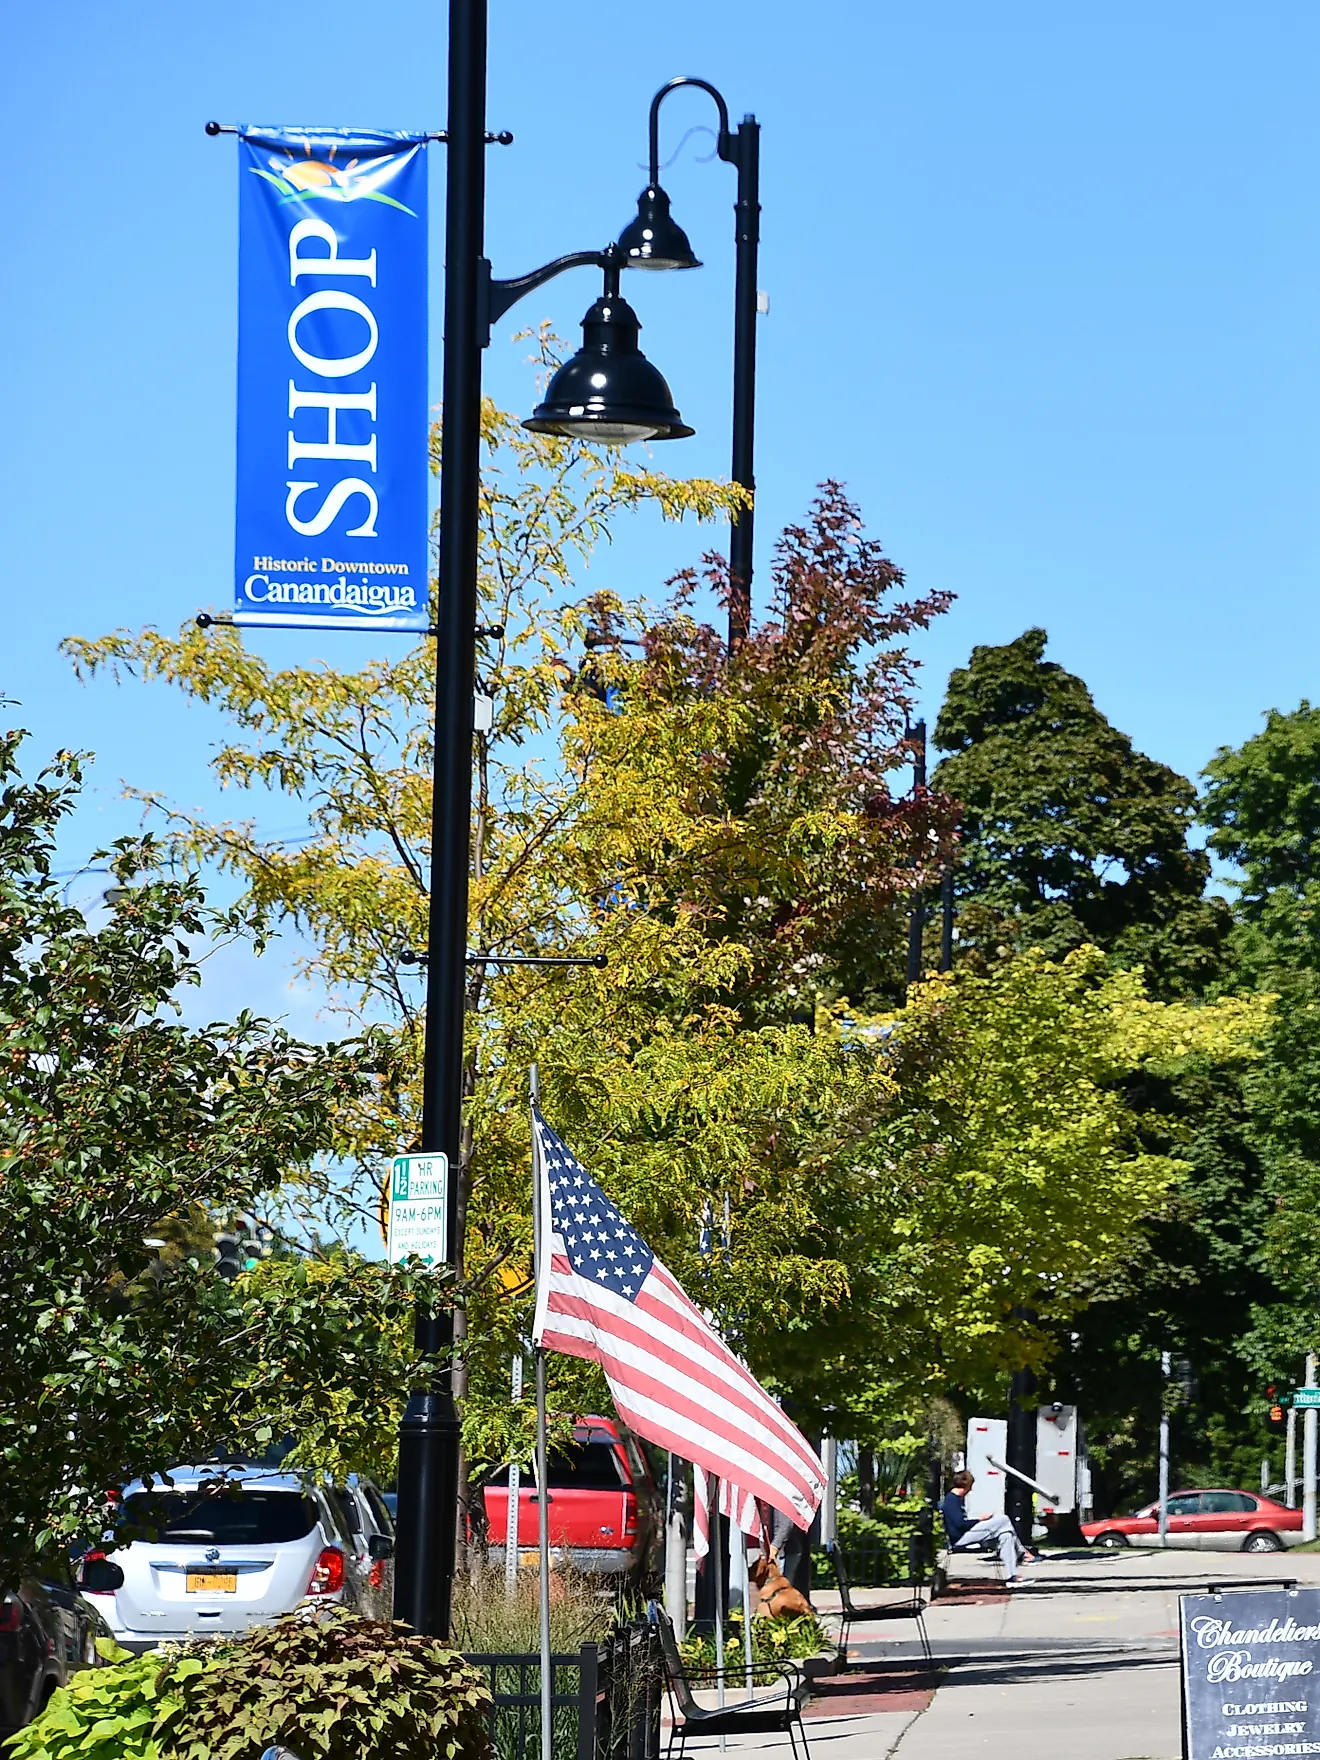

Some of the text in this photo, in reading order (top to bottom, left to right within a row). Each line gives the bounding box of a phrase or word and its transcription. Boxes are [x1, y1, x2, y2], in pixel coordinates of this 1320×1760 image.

[285, 217, 379, 538] SHOP
[253, 556, 410, 576] Historic Downtown
[244, 573, 416, 611] Canandaigua
[419, 1162, 433, 1177] HR
[410, 1179, 443, 1196] PARKING
[395, 1206, 442, 1222] 9AM-6PM
[394, 1226, 440, 1237] EXCEPT SUNDAYS
[398, 1241, 437, 1250] AND HOLIDAYS
[1206, 1650, 1314, 1684] Boutique
[1221, 1700, 1309, 1718] CLOTHING
[1226, 1721, 1307, 1738] JEWELRY
